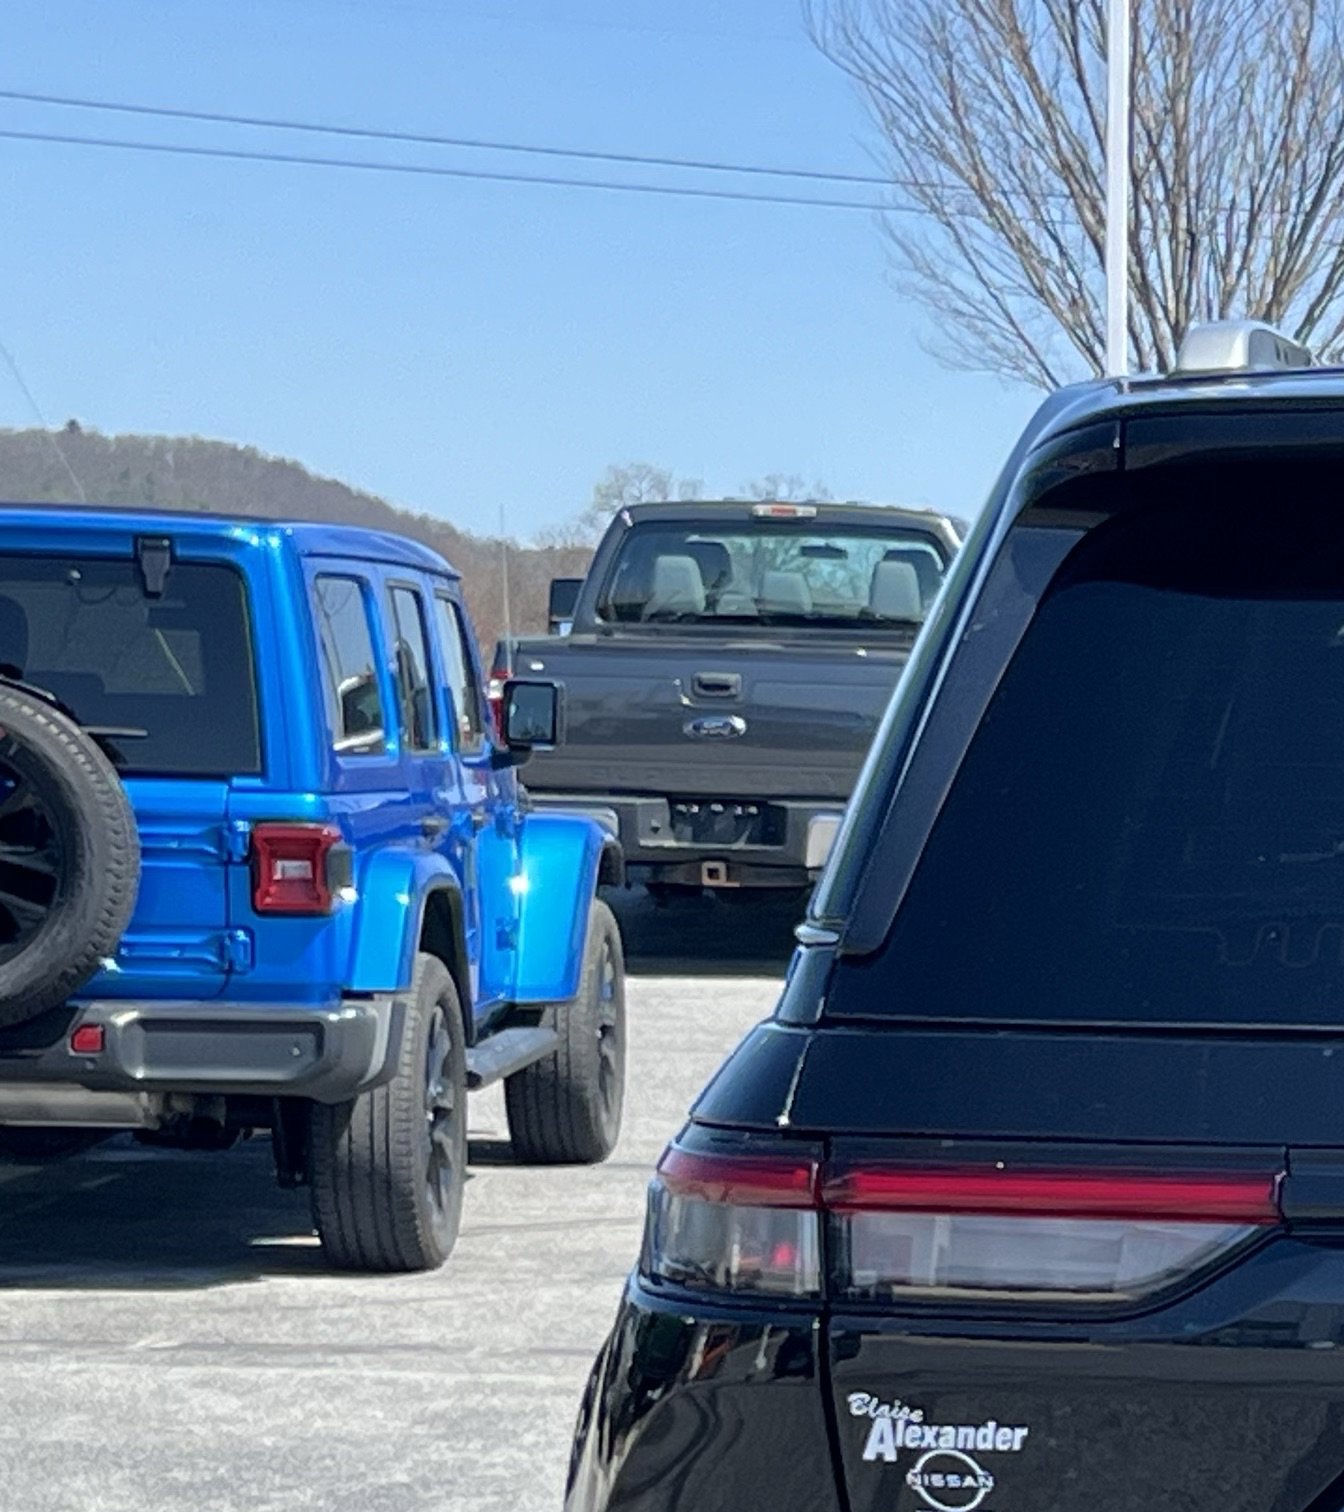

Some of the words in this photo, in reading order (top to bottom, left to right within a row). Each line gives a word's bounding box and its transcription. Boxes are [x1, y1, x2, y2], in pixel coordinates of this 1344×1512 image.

[848, 1391, 924, 1423] Blaise
[862, 1418, 1029, 1462] Alexander
[906, 1470, 995, 1490] NISSAN
